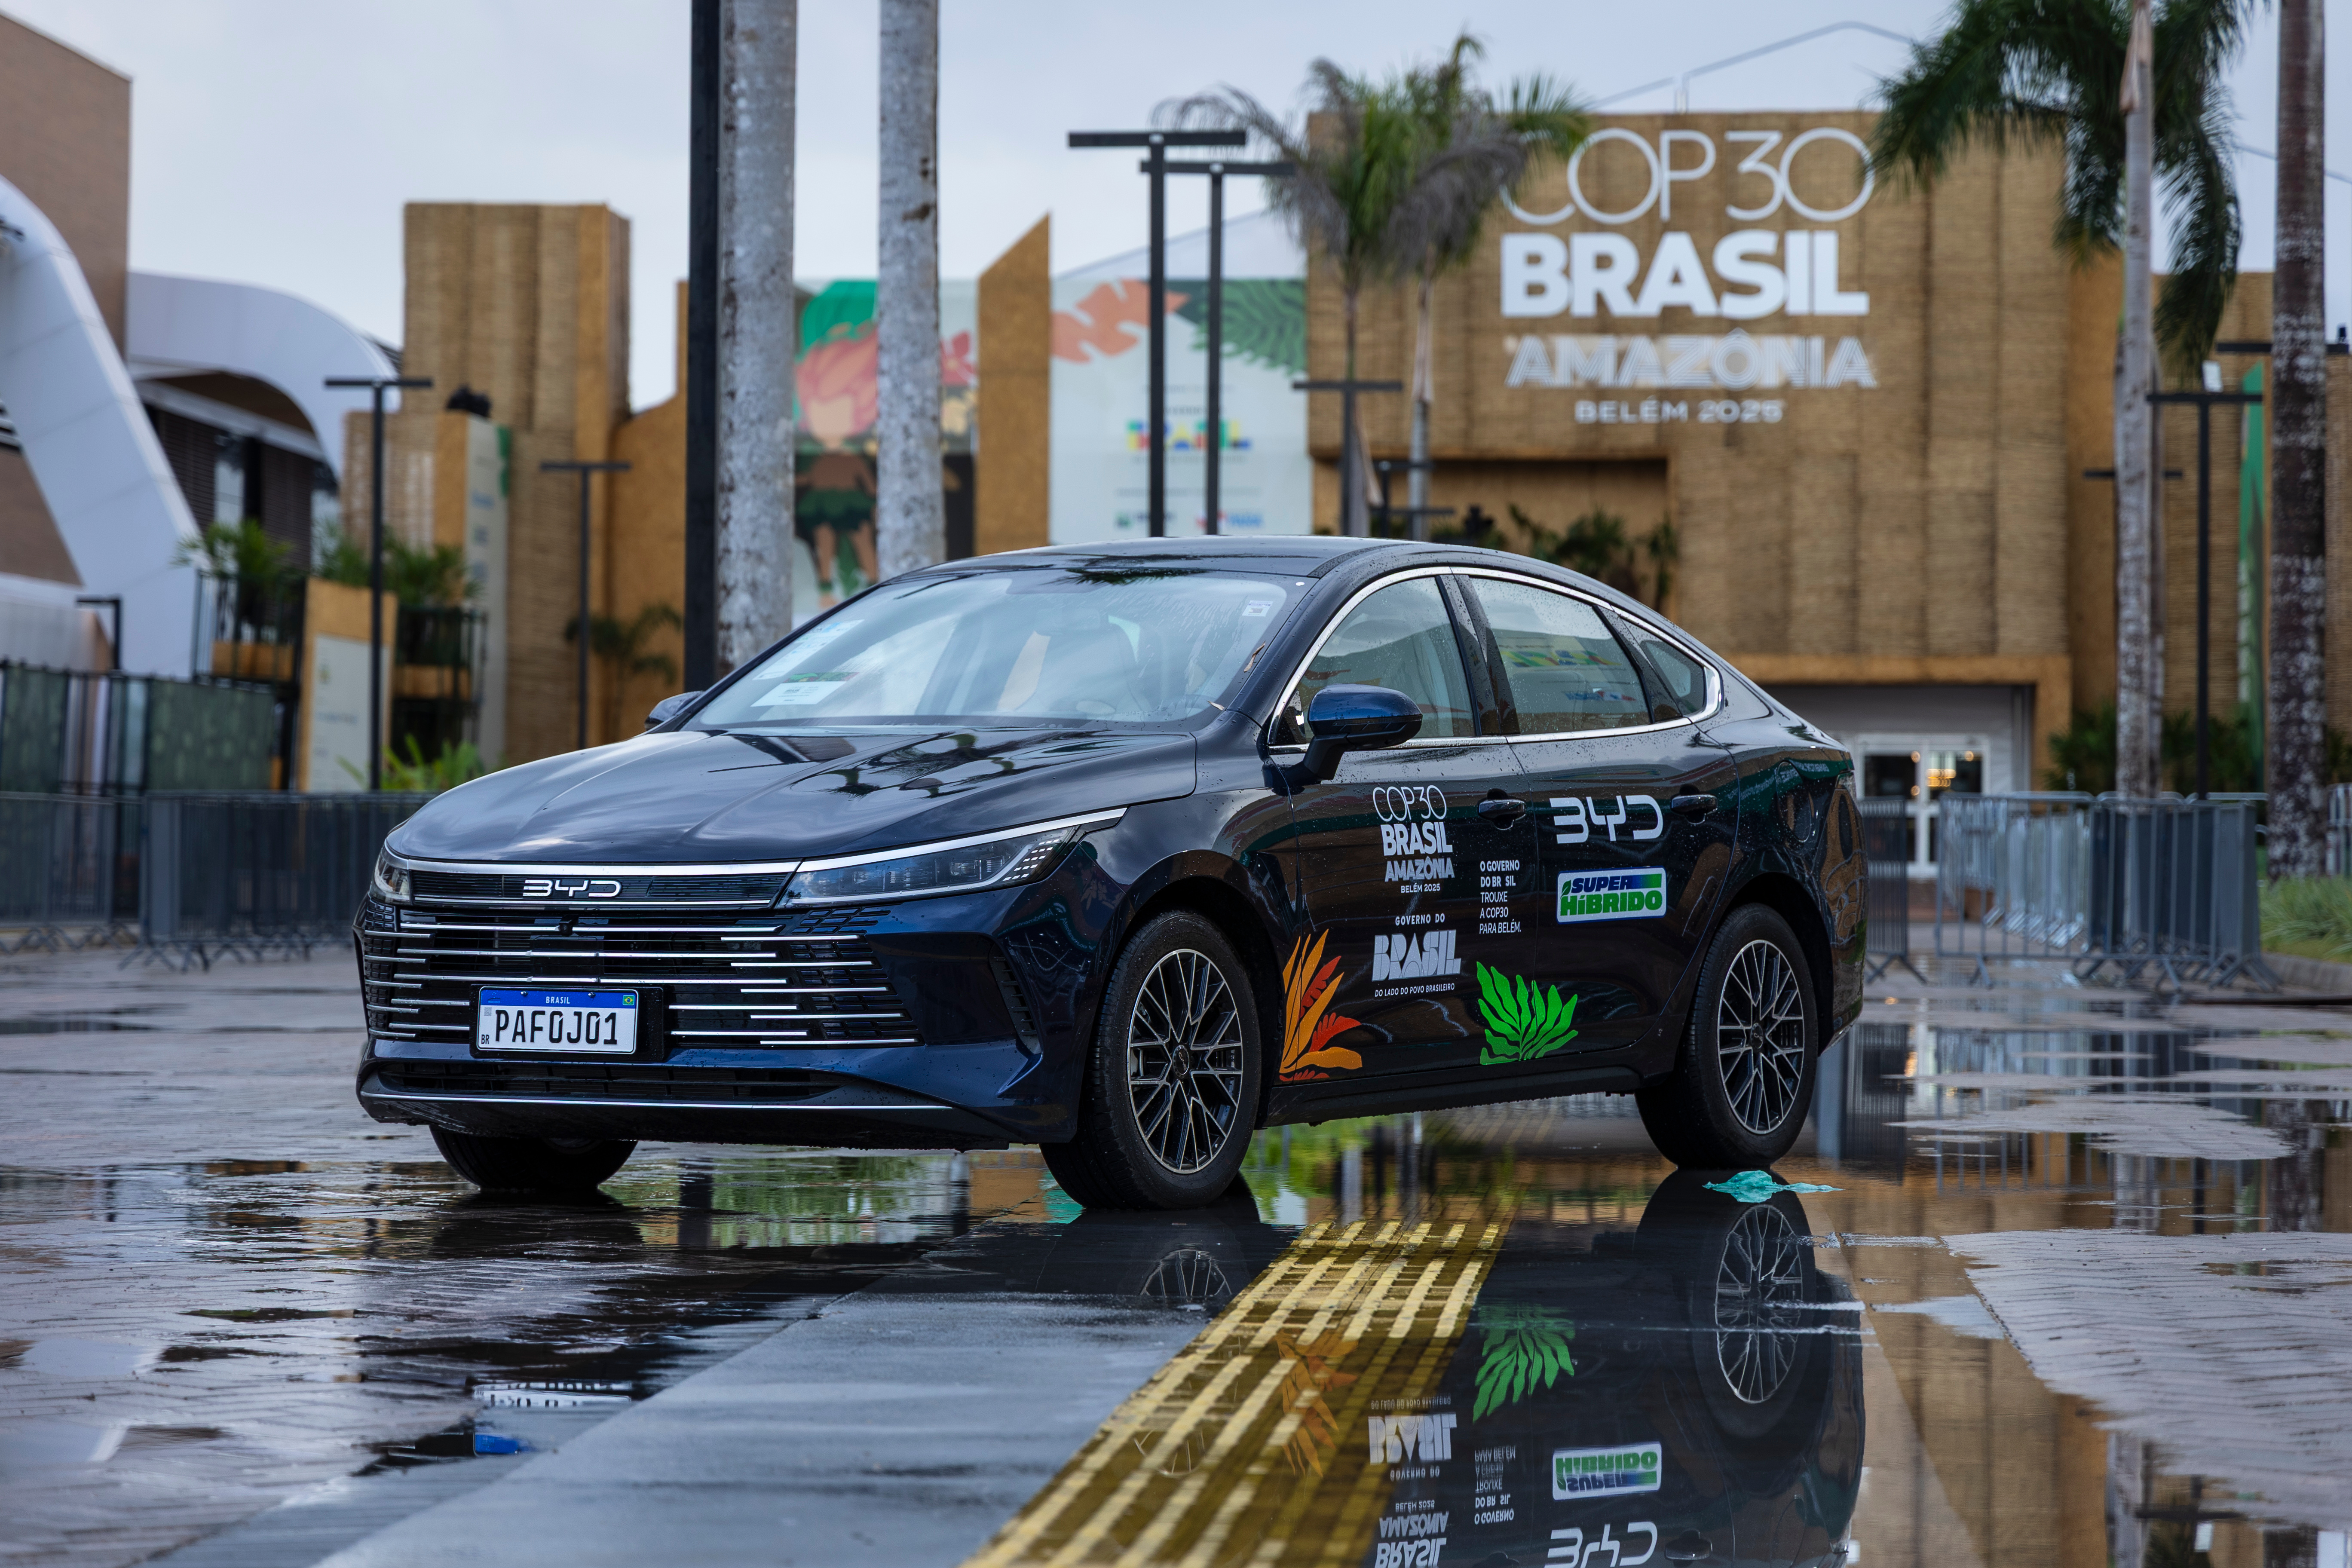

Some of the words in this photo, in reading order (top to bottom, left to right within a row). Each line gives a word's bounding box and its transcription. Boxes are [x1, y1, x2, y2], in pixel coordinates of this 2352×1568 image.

[1499, 229, 1870, 319] BRASIL
[1504, 327, 1878, 392] AMAZÔNIA
[1575, 395, 1687, 424] BELÉM
[1698, 400, 1784, 424] 2025
[1549, 795, 1663, 844] BYD
[1381, 821, 1453, 856] BRASIL
[1384, 855, 1455, 882] AMAZÔNIA
[1480, 861, 1485, 872] O
[1487, 860, 1520, 872] GOVERNO
[523, 879, 622, 897] BYD
[1401, 882, 1422, 893] BELÉM
[1424, 883, 1440, 892] 2025
[1480, 876, 1491, 887] DO
[1571, 875, 1632, 894] SUPER
[1480, 891, 1508, 903] TROUXE
[1395, 914, 1431, 926] GOVERNO
[1435, 913, 1445, 923] DO
[1480, 908, 1485, 919] A
[1486, 906, 1509, 918] COP30
[1479, 923, 1497, 934] PARA
[1498, 919, 1521, 933] BELÉM.
[1372, 929, 1461, 982] BRASIL
[1384, 988, 1399, 996] LADO
[1410, 986, 1424, 994] POVO
[1426, 983, 1455, 992] BRASILEIRO
[495, 1009, 618, 1045] PAF0J01
[481, 1034, 490, 1044] BR
